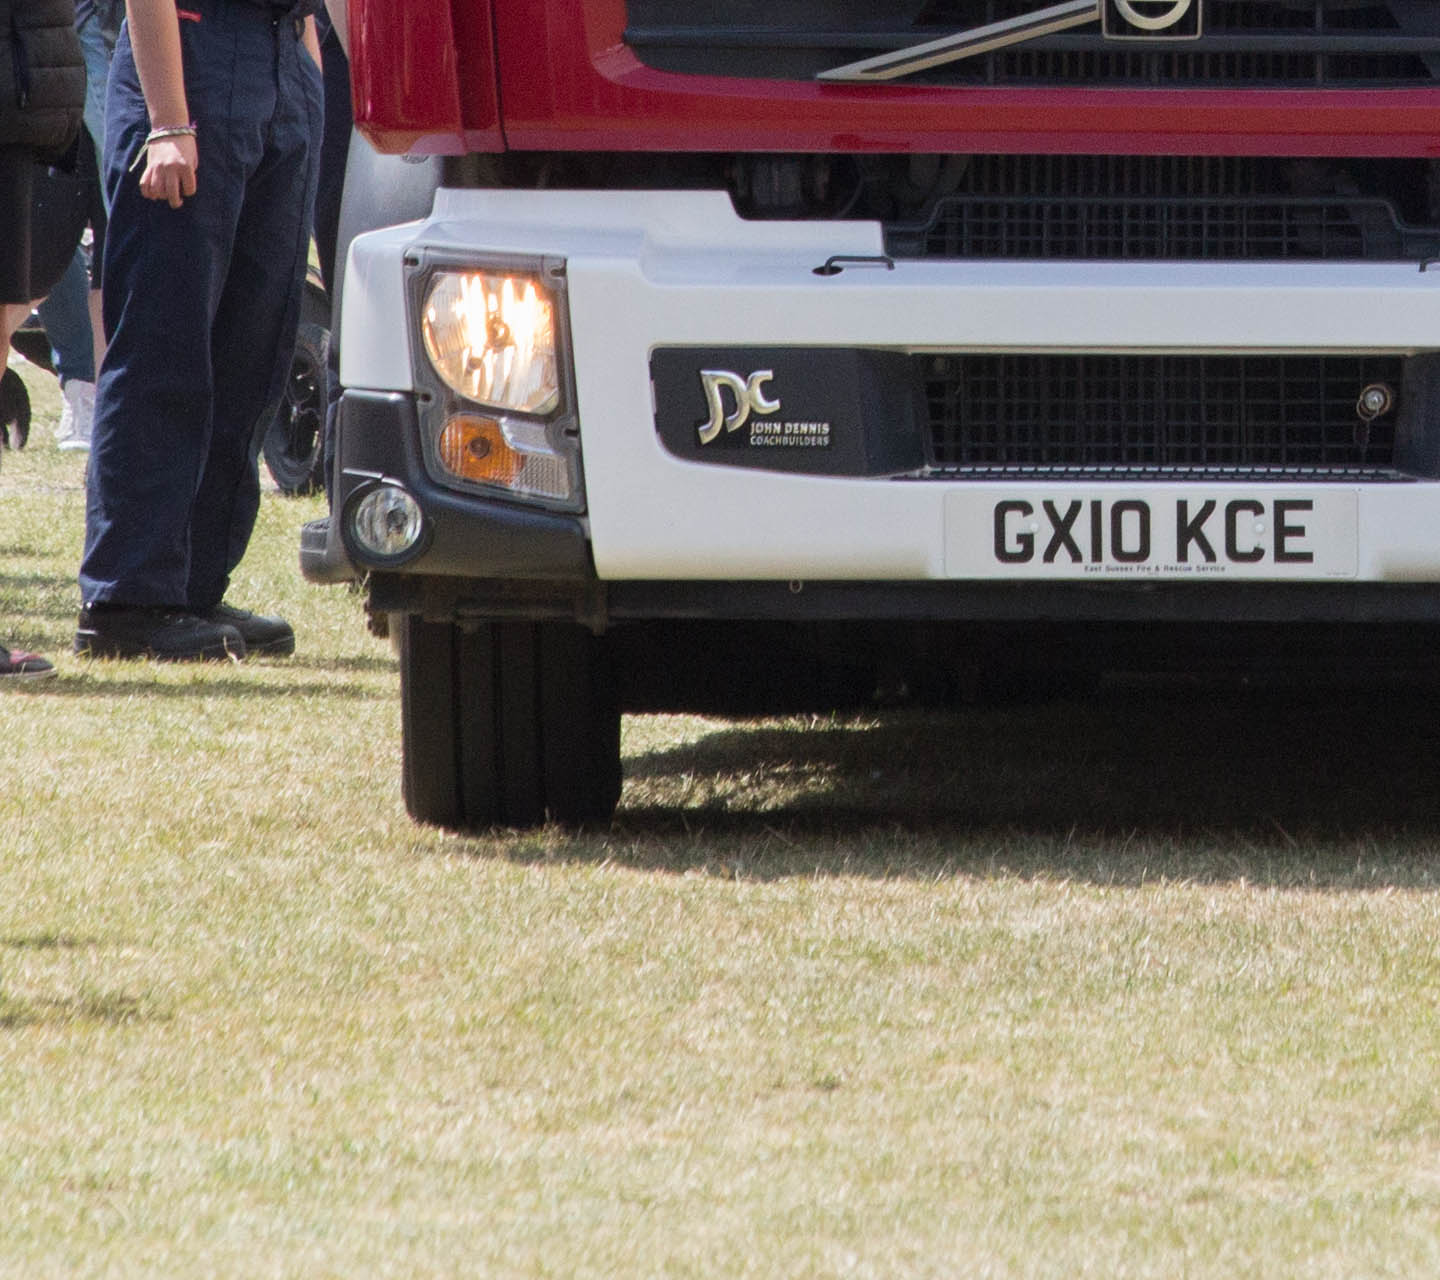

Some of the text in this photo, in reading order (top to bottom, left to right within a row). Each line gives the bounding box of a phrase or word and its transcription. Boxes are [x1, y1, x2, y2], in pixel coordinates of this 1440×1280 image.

[750, 421, 831, 435] JOHN DENNIS
[749, 435, 831, 447] COACHBUILDERS
[993, 499, 1314, 564] GX10 KCE
[1084, 565, 1102, 573] East
[1136, 565, 1151, 573] Fire
[1163, 565, 1192, 573] Rescue
[1196, 565, 1226, 573] Service
